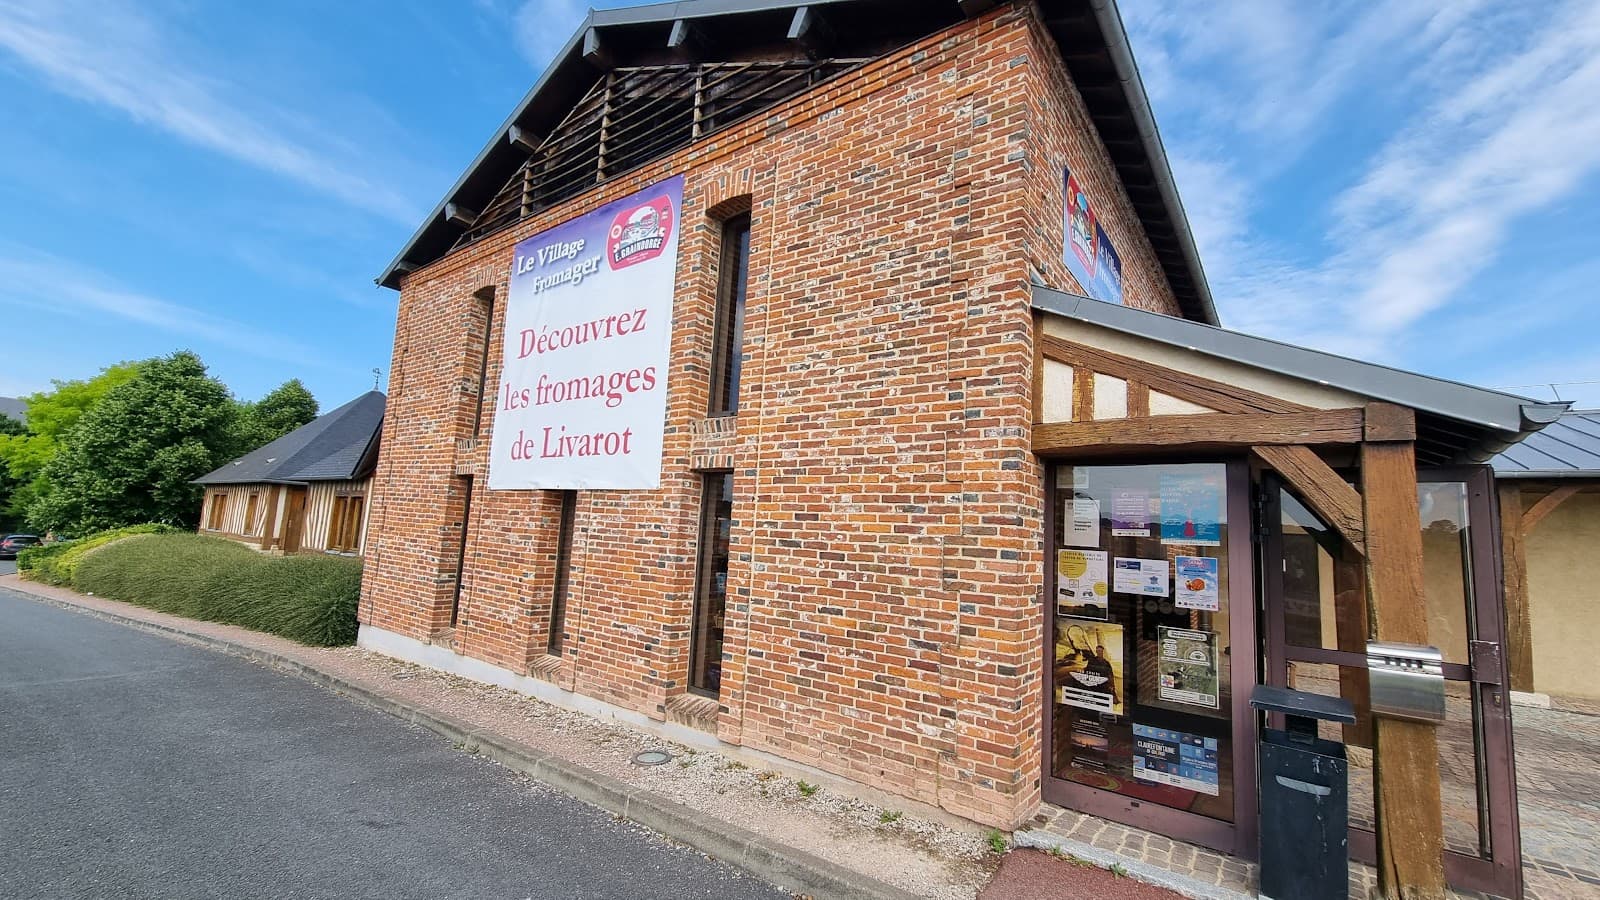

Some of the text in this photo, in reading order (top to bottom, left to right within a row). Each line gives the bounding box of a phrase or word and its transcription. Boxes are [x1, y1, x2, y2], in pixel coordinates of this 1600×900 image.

[517, 238, 585, 277] Le Village
[533, 255, 601, 294] Fromager
[518, 309, 647, 359] Découvrez
[504, 366, 656, 411] les fromages
[511, 425, 633, 461] de Livarot
